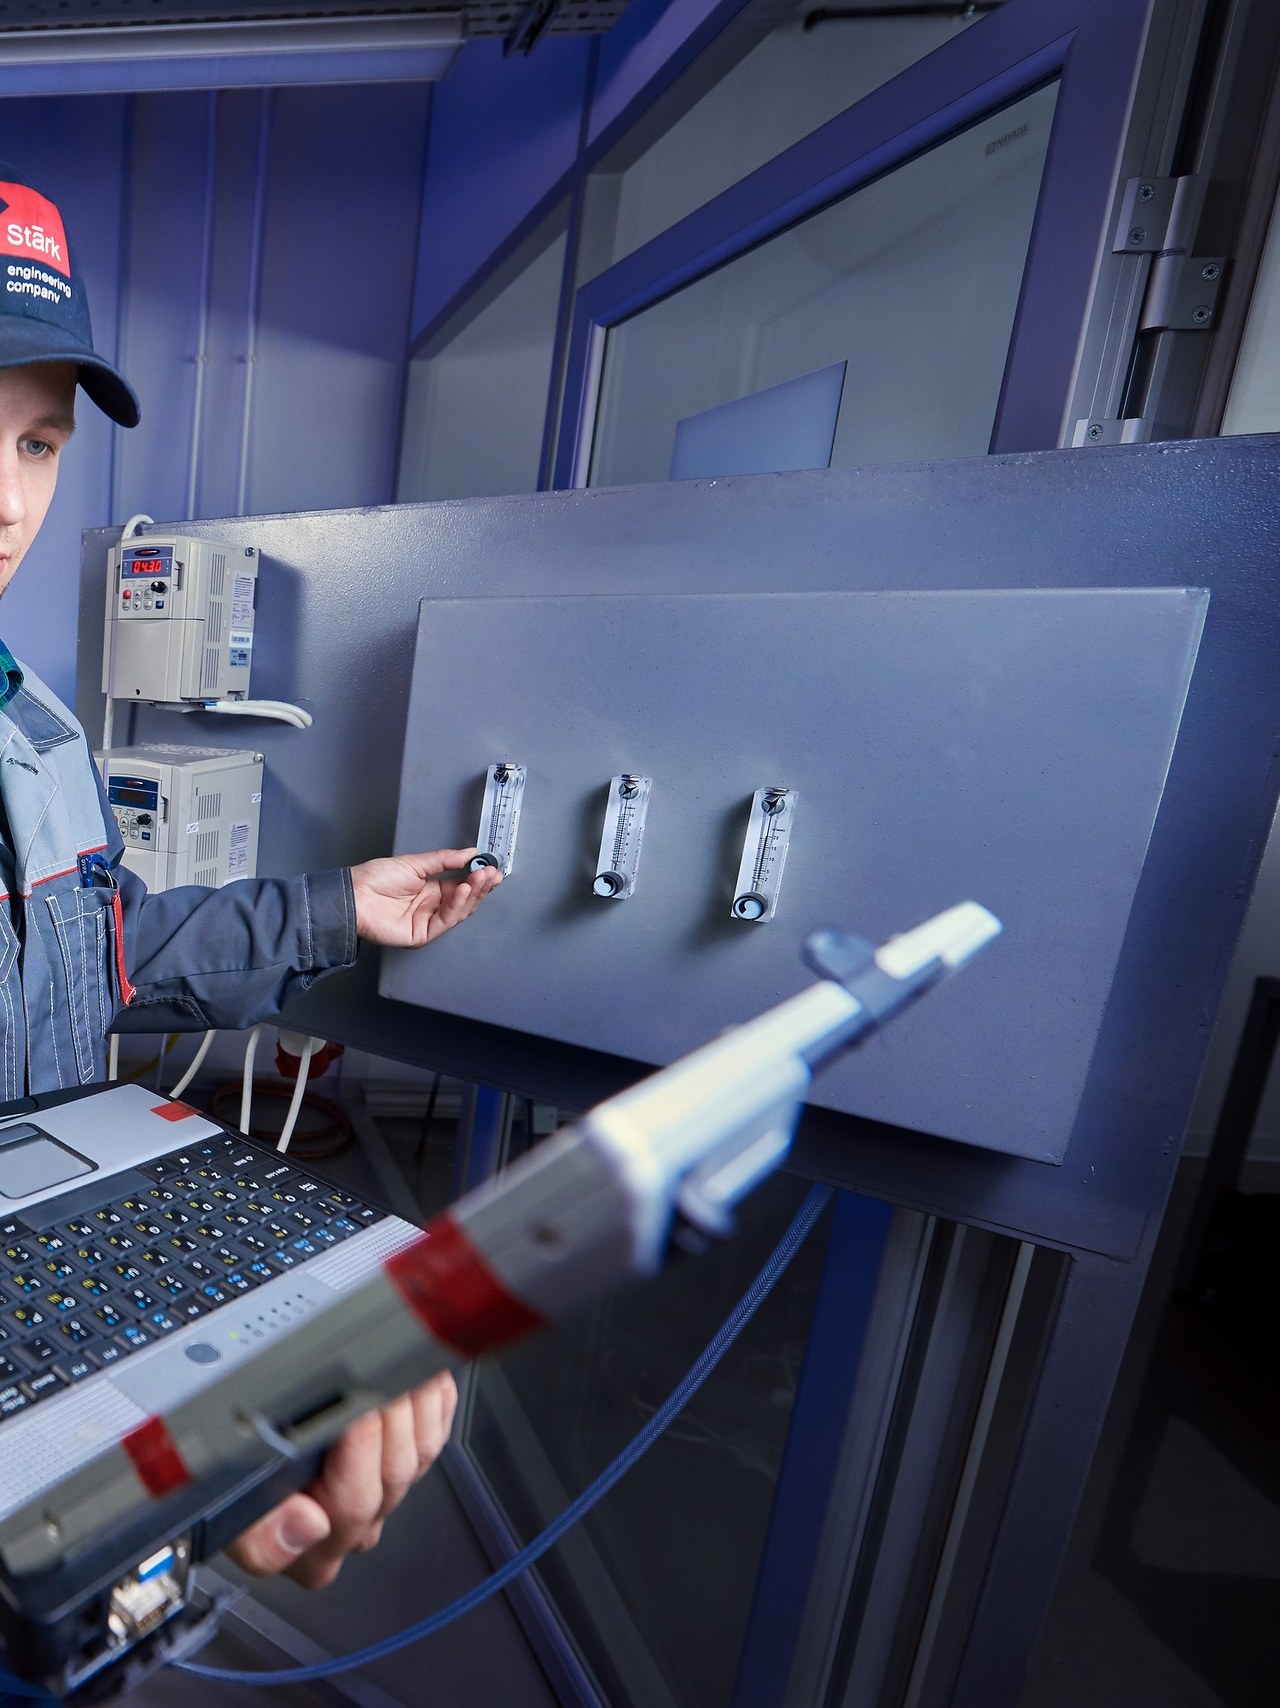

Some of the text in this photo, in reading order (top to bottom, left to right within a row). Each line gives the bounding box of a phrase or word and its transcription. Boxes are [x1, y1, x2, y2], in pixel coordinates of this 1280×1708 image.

[6, 223, 61, 261] Stārk
[6, 280, 61, 304] company
[7, 265, 72, 298] engineering
